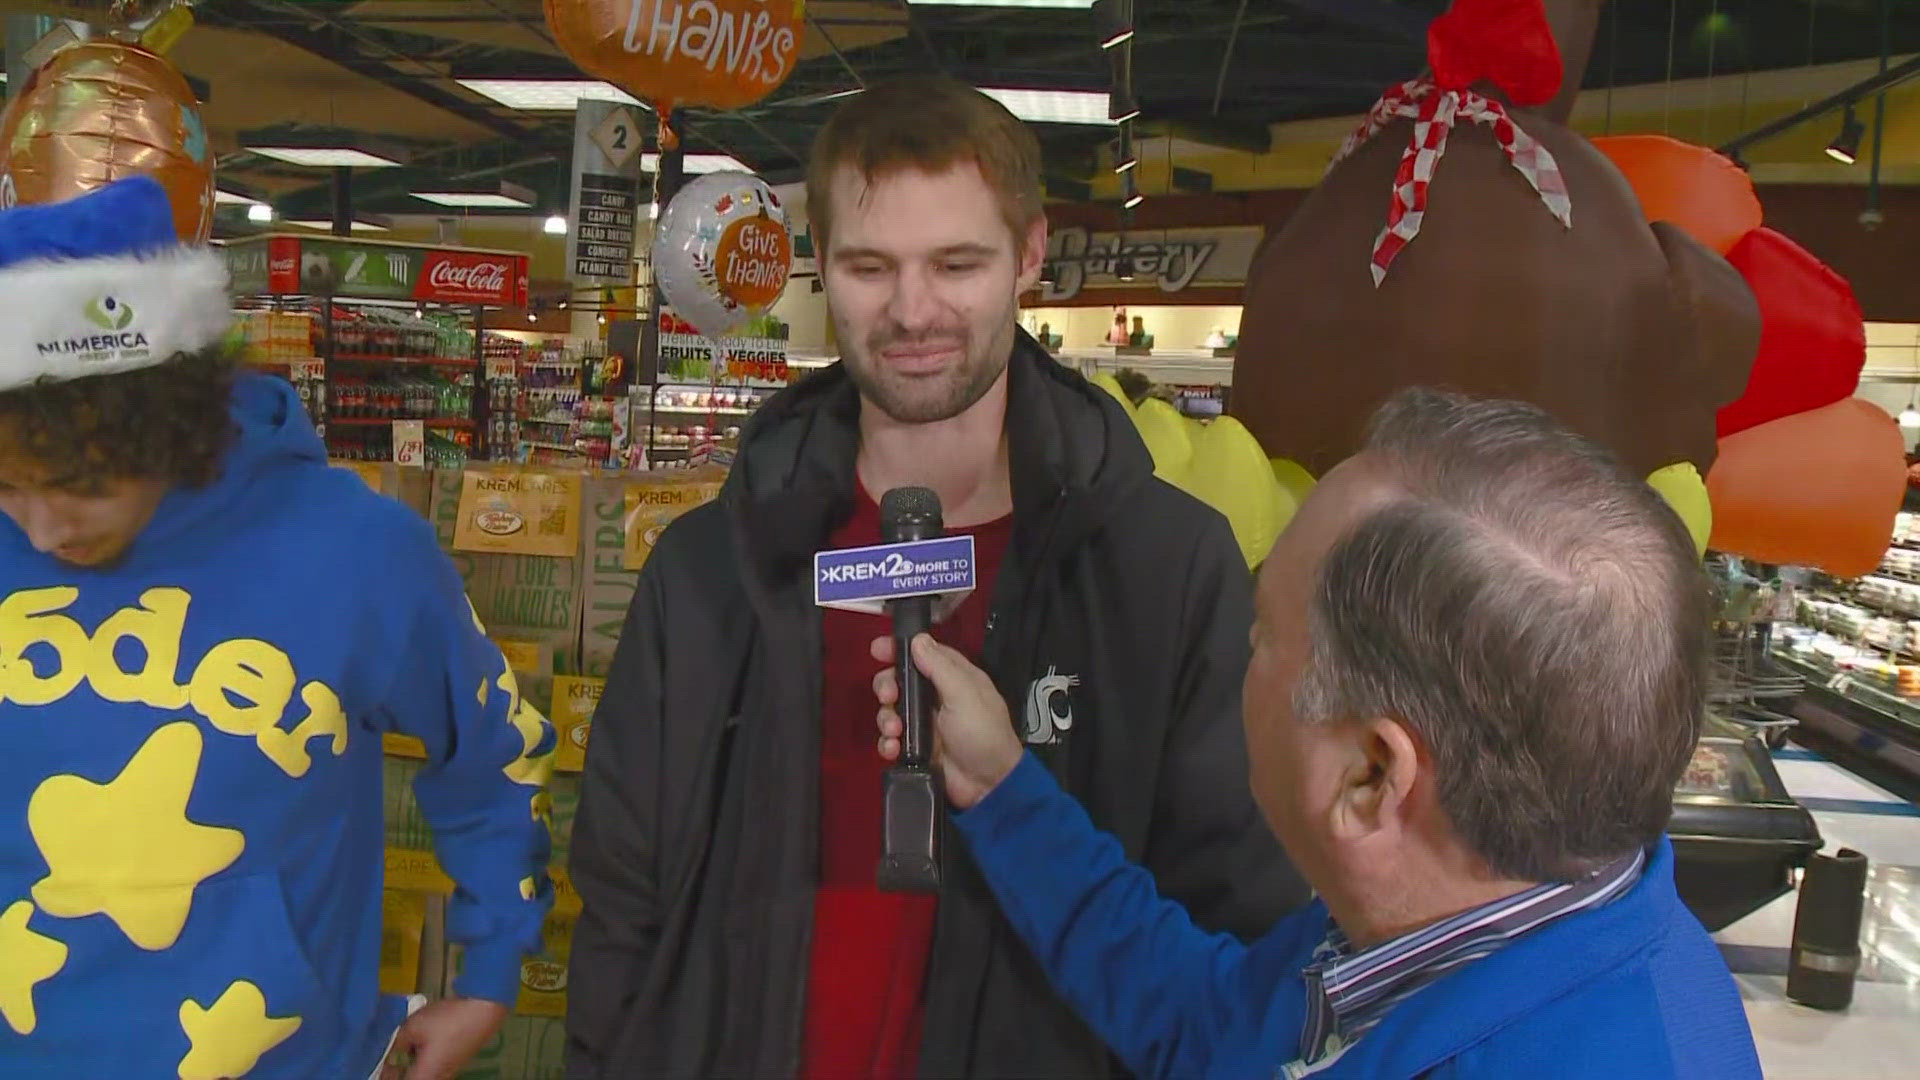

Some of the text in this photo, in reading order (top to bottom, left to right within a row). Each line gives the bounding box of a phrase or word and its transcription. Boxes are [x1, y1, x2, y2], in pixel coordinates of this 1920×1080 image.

[611, 124, 628, 149] 2
[601, 193, 626, 208] CANDY
[587, 210, 614, 223] CANDY
[581, 226, 606, 240] SALAD
[579, 261, 609, 276] PEANUT
[1041, 224, 1218, 301] Bakery
[430, 260, 508, 291] Coca-Cola
[36, 331, 149, 357] NUMERICA
[661, 346, 712, 360] FRUITS
[727, 349, 786, 364] VEGGIES
[515, 557, 558, 586] LOVE
[591, 498, 637, 640] AUERS
[915, 561, 949, 573] MORE
[953, 558, 968, 569] TO
[892, 571, 968, 589] EVERY STORY
[495, 586, 571, 629] HANDLES
[568, 682, 604, 700] KRE
[384, 855, 434, 874] CARE
